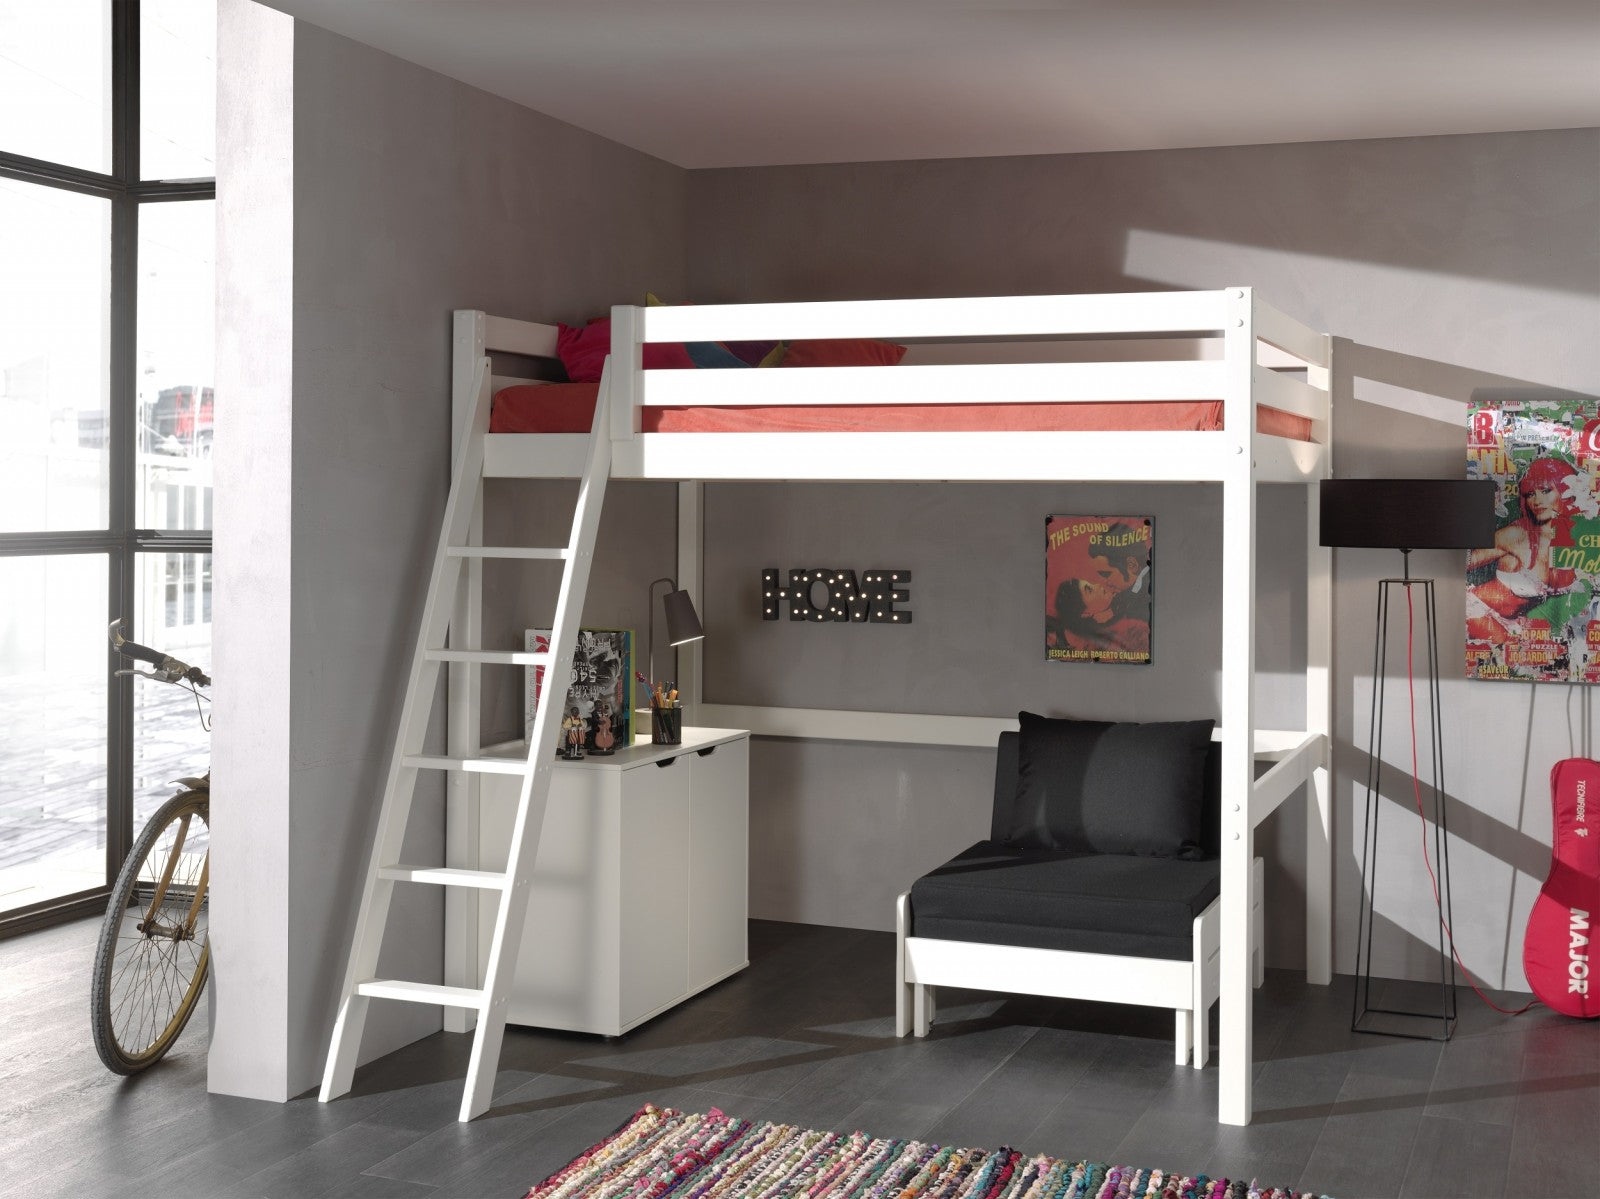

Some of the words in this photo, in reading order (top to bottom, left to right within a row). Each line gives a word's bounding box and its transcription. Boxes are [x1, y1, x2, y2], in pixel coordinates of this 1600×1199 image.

[1049, 527, 1070, 551] THE
[1072, 522, 1109, 537] SOUND
[1089, 534, 1103, 545] OF
[1105, 525, 1149, 547] SILENCE
[762, 568, 912, 624] HOME
[1048, 649, 1071, 659] JESSICA
[1071, 650, 1088, 659] LEIGH
[1090, 651, 1118, 660] ROBERTO
[1119, 651, 1150, 660] GALLIANO
[1568, 907, 1590, 994] MAJOR
